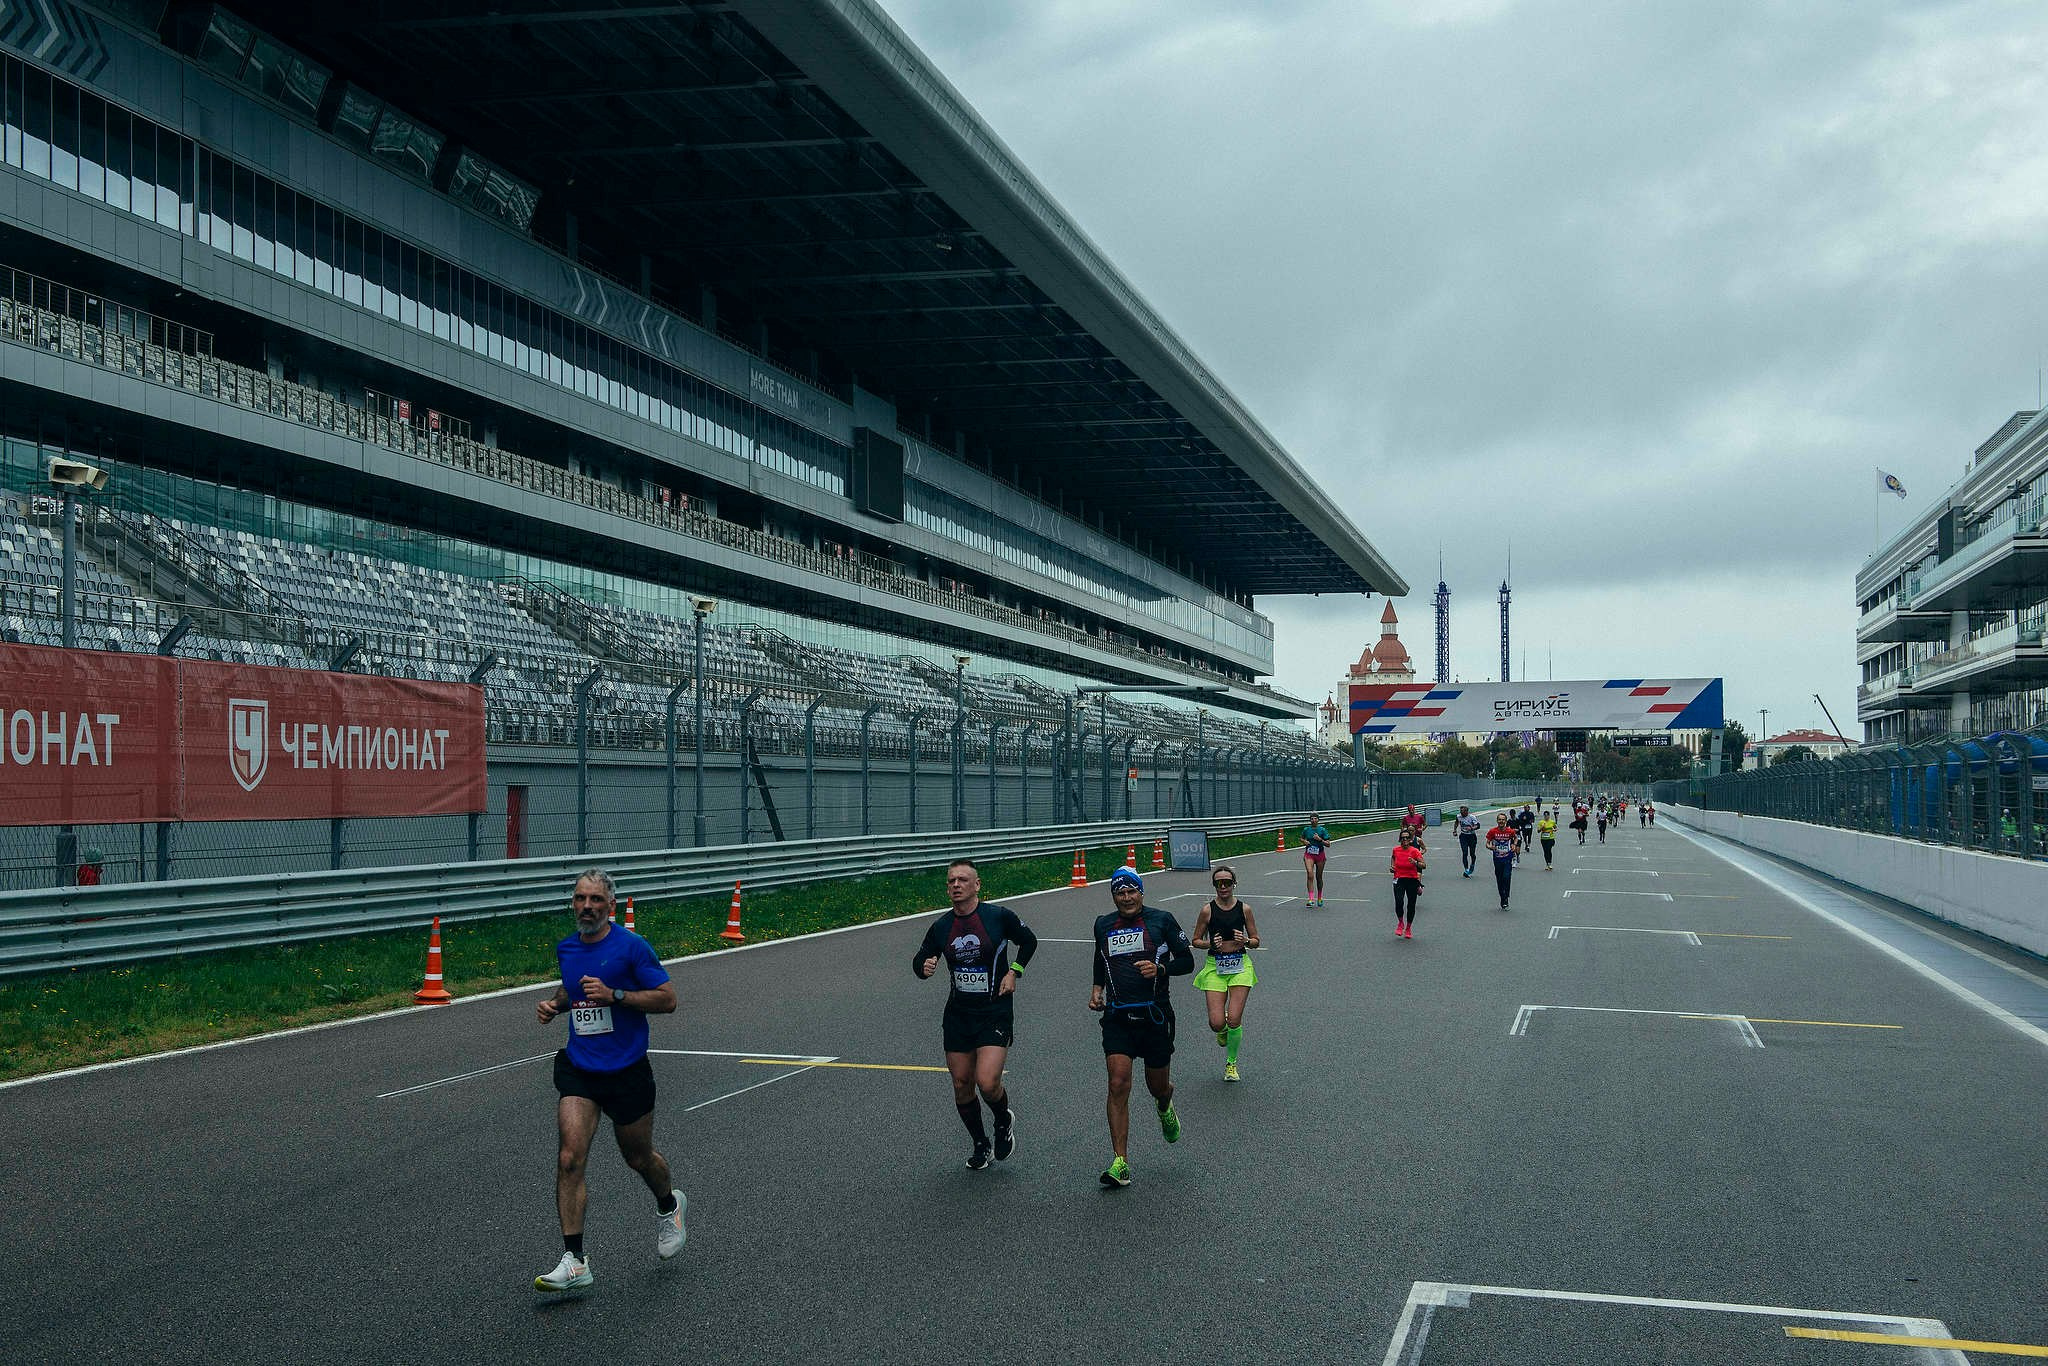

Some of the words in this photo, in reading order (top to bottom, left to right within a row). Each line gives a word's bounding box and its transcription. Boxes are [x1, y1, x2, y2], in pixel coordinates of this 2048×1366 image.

[750, 368, 775, 398] MORE
[776, 382, 799, 409] THAN
[1494, 699, 1570, 710] СИРИУС
[280, 722, 450, 770] ЧЕМПИОНАТ
[1112, 933, 1140, 946] 5027
[1219, 959, 1240, 968] 4547
[956, 973, 986, 983] 4904
[576, 1009, 603, 1022] 8611
